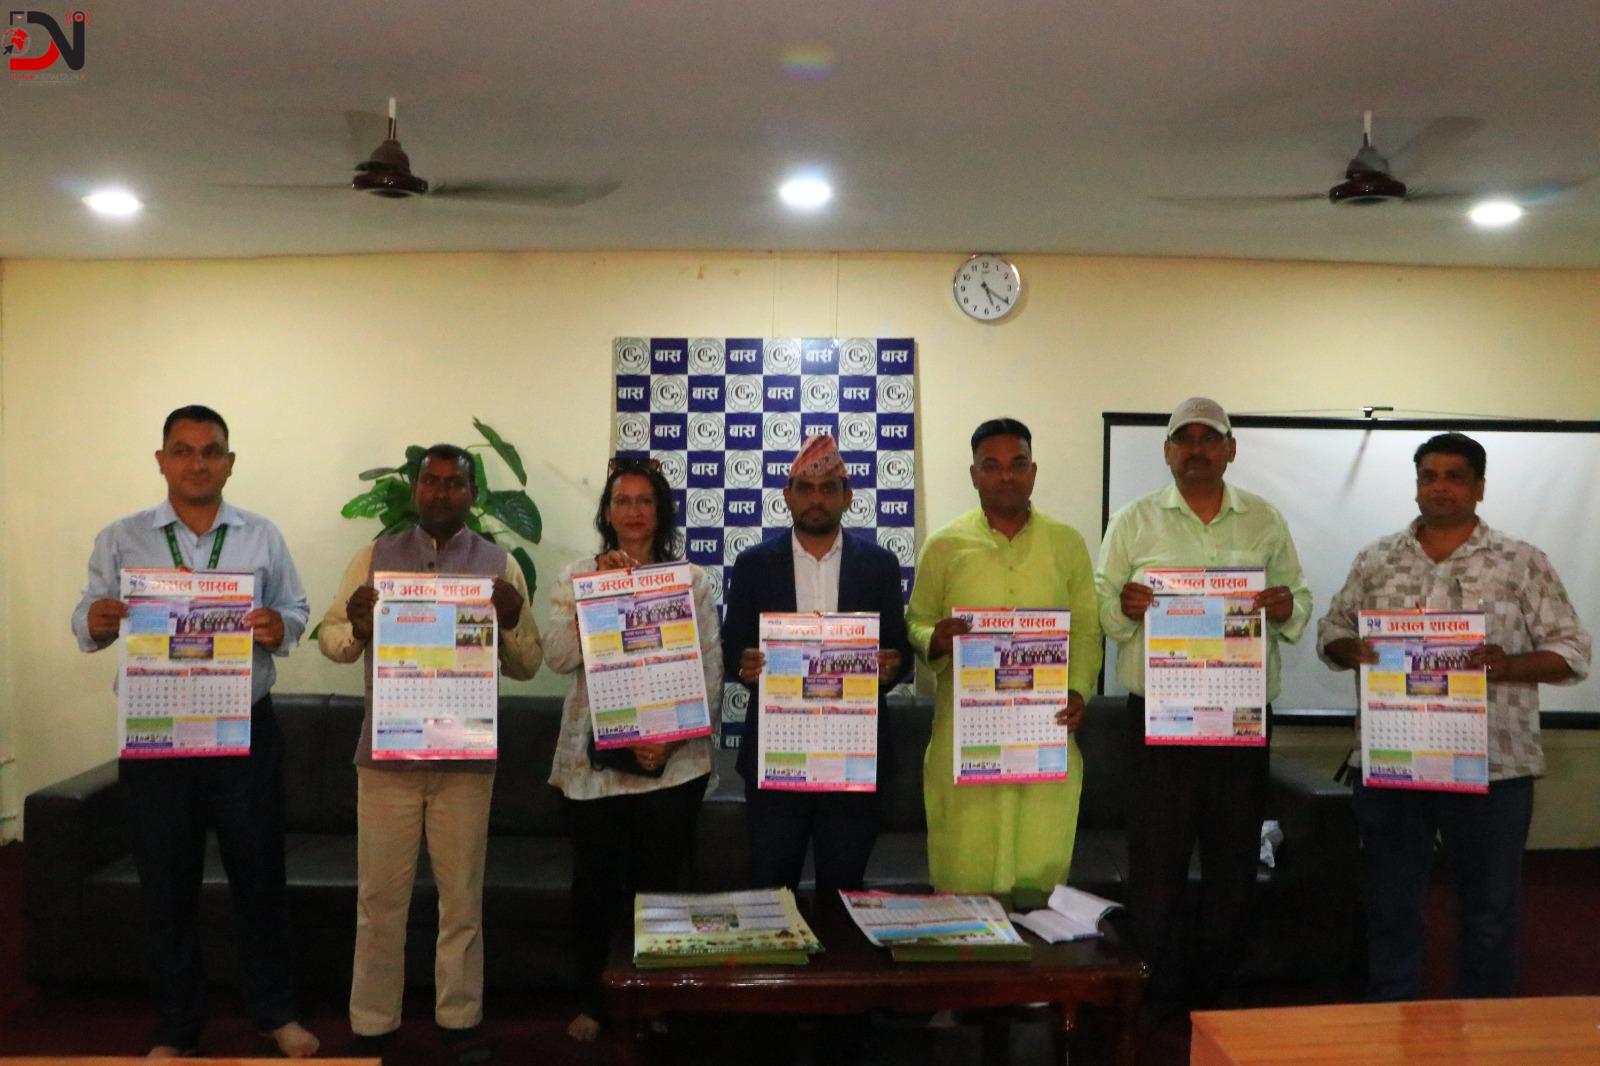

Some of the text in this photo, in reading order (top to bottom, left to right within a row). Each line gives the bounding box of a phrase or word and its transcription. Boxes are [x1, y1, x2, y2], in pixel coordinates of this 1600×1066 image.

[654, 349, 682, 363] बास
[729, 349, 757, 363] बास
[881, 350, 908, 363] बास
[617, 386, 644, 400] बास
[692, 387, 719, 400] बास
[767, 387, 795, 400] बास
[843, 387, 870, 400] बास
[654, 424, 681, 438] बास
[729, 425, 756, 438] बास
[880, 425, 908, 438] बास
[691, 462, 719, 476] बास
[728, 501, 756, 515] बास
[880, 501, 908, 515] बास
[690, 539, 718, 553] बास
[198, 579, 239, 593] शासन
[598, 577, 634, 592] असल
[638, 572, 675, 586] शासन
[1209, 577, 1248, 590] शासन
[442, 584, 480, 597] शासन
[978, 616, 1014, 629] असल
[1019, 616, 1057, 629] शासन
[1388, 620, 1424, 633] असल
[1429, 620, 1470, 633] शासन
